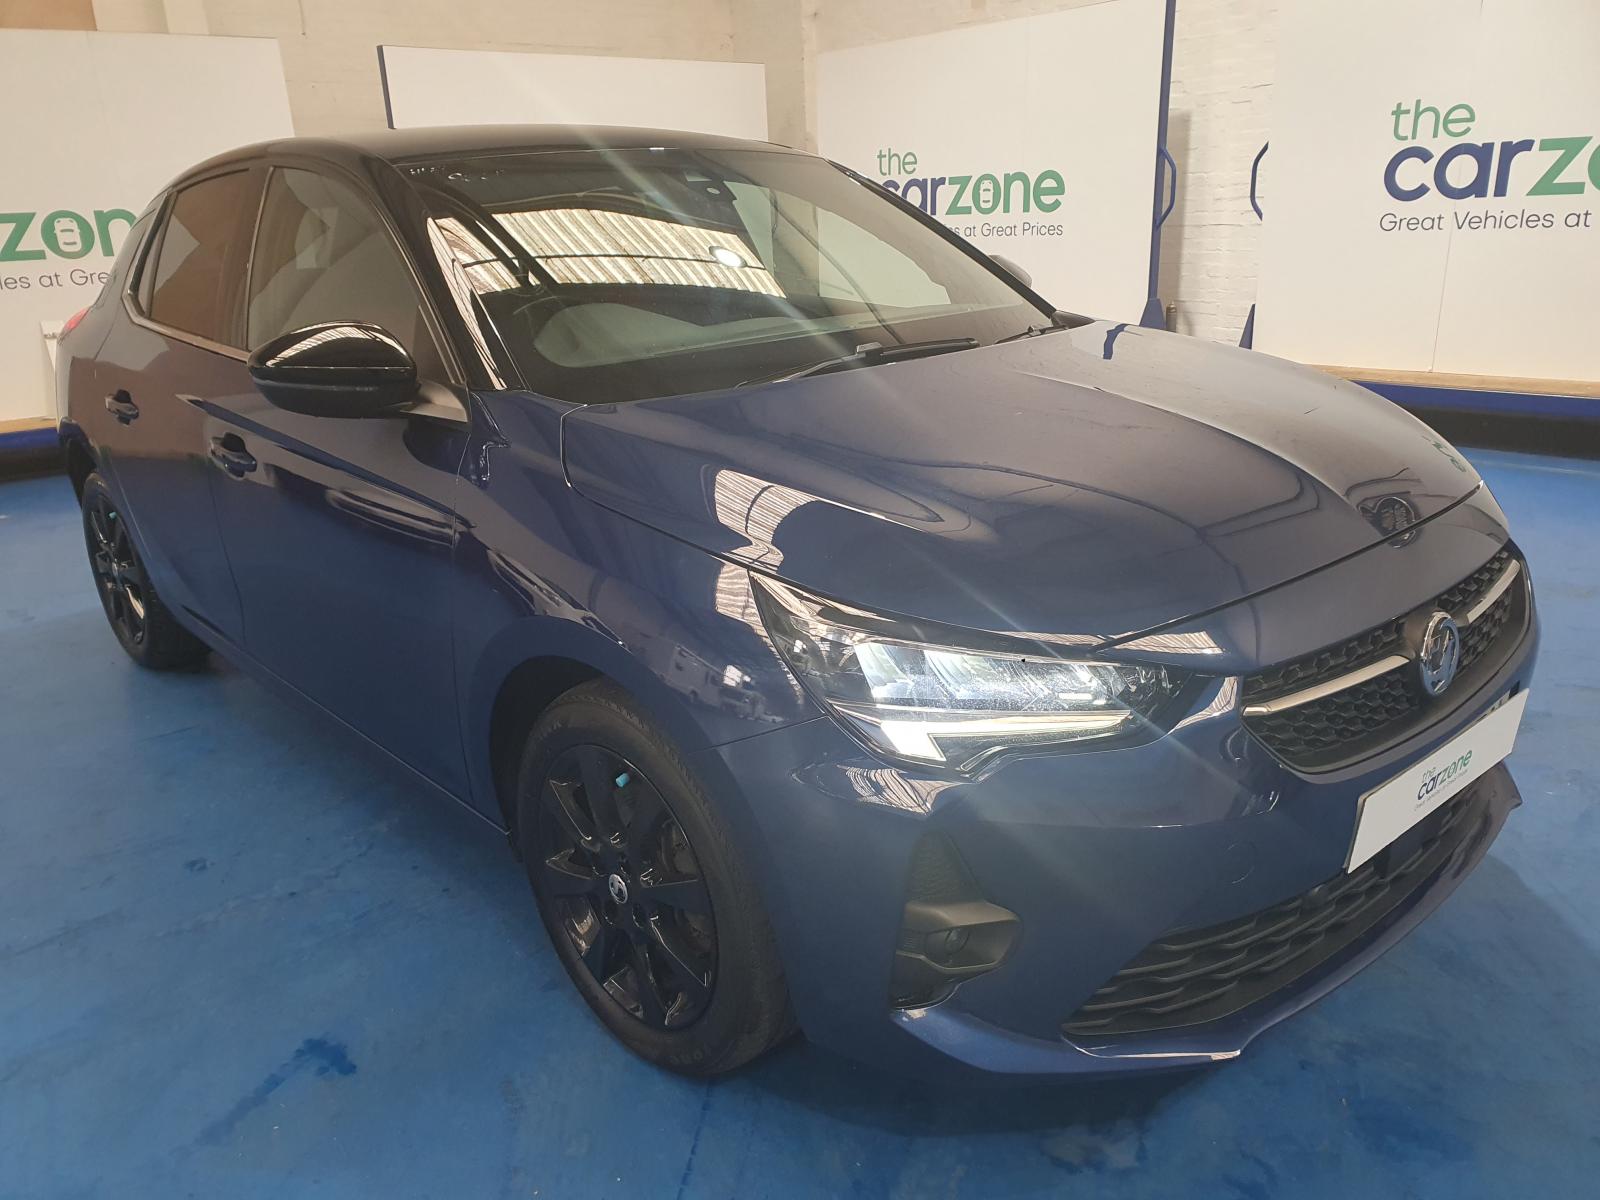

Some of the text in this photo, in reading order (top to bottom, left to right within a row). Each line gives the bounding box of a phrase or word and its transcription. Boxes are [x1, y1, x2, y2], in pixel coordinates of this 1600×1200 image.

[1391, 99, 1476, 141] the
[877, 148, 918, 176] the
[1383, 136, 1600, 202] carz
[964, 225, 977, 237] at
[981, 222, 1017, 237] Great
[1022, 221, 1064, 236] Prices
[1379, 209, 1592, 231] Great Vehicles at
[38, 271, 63, 288] at
[1417, 749, 1473, 801] carzone
